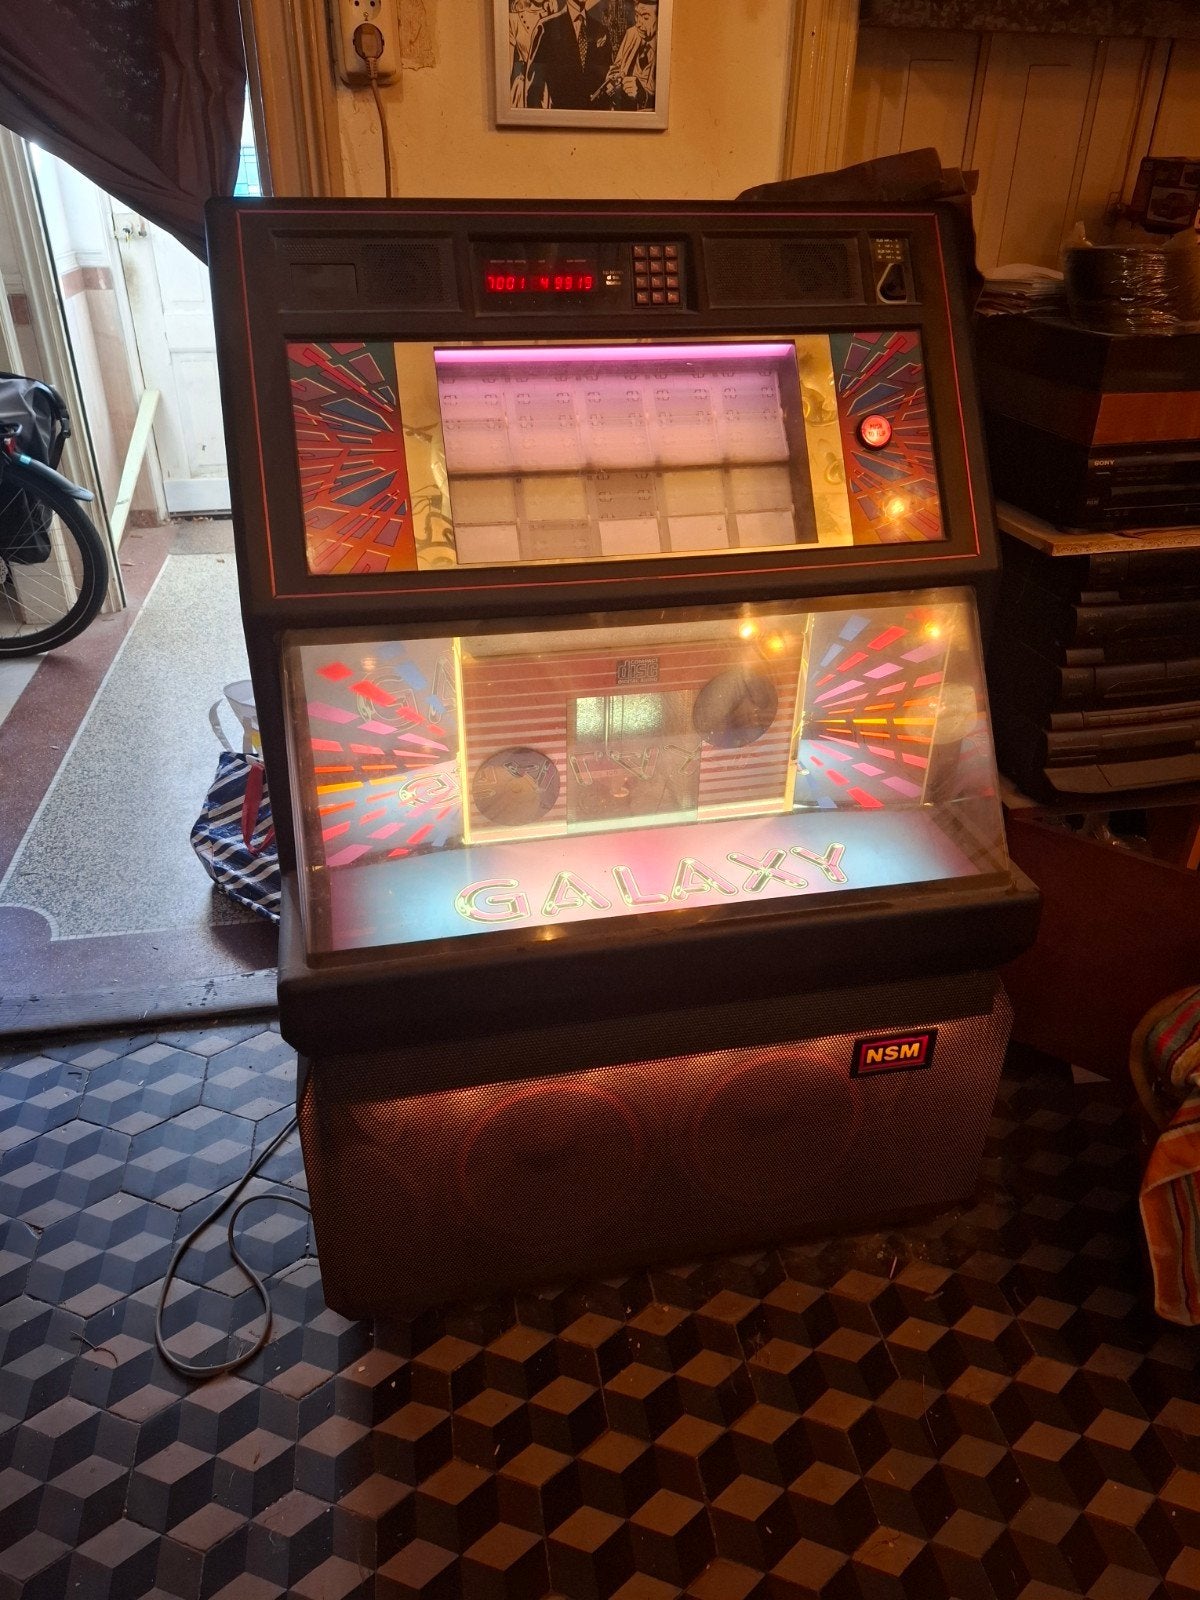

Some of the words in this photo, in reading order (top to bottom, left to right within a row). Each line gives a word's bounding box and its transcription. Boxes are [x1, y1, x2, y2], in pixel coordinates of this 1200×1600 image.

[1094, 459, 1115, 467] SONY
[455, 842, 849, 924] GALAXY
[867, 1043, 920, 1063] NSM
